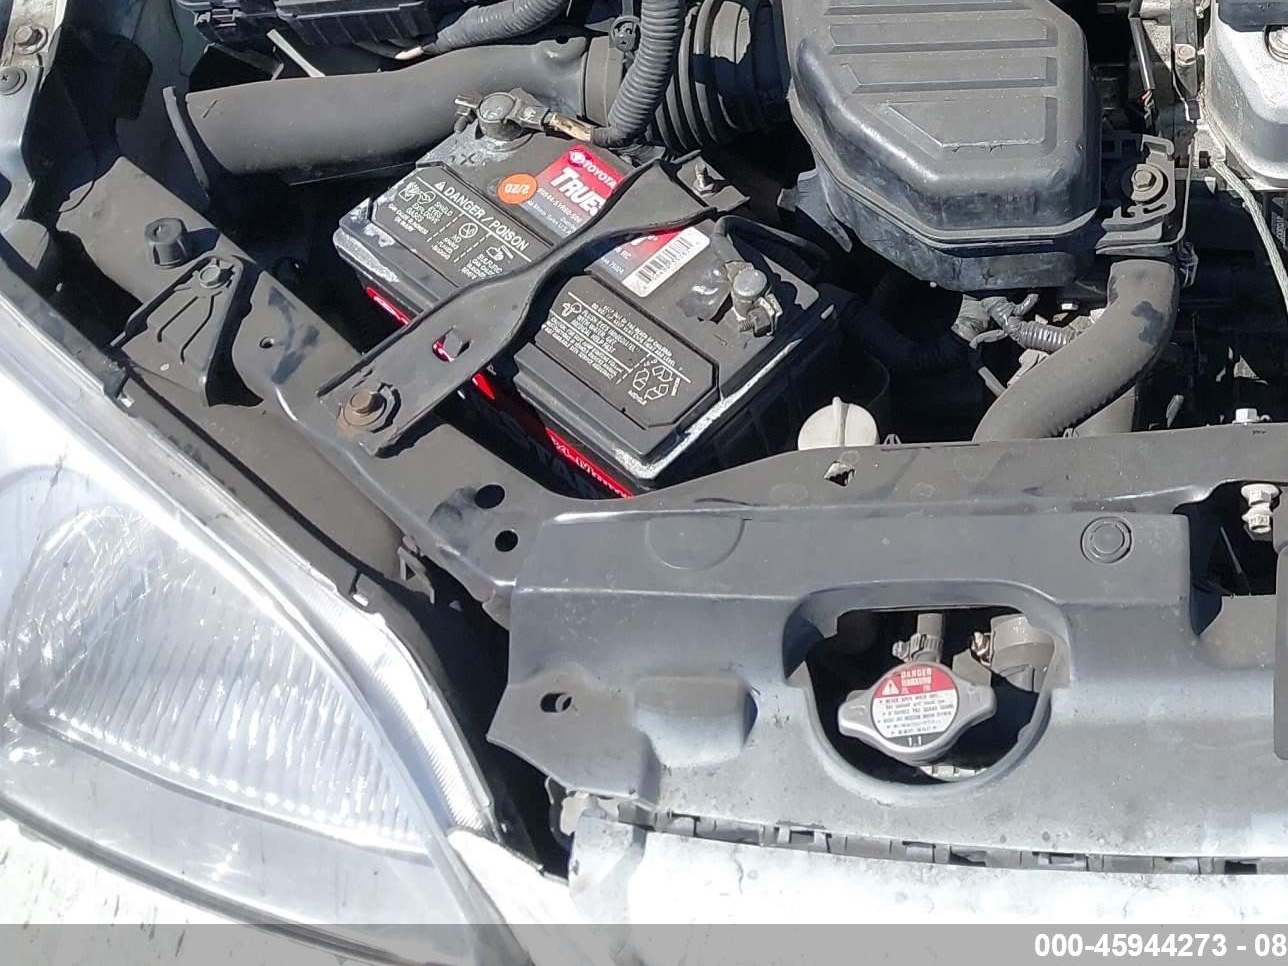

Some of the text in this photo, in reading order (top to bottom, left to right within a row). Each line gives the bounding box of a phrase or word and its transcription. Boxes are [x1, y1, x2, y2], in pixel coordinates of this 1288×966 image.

[581, 159, 619, 190] TOYOTA
[504, 182, 530, 195] 2/20
[426, 205, 442, 218] EYES
[442, 186, 487, 220] DANGER
[488, 219, 530, 251] POISON
[900, 667, 932, 677] DANGER
[907, 735, 922, 747] 1.1
